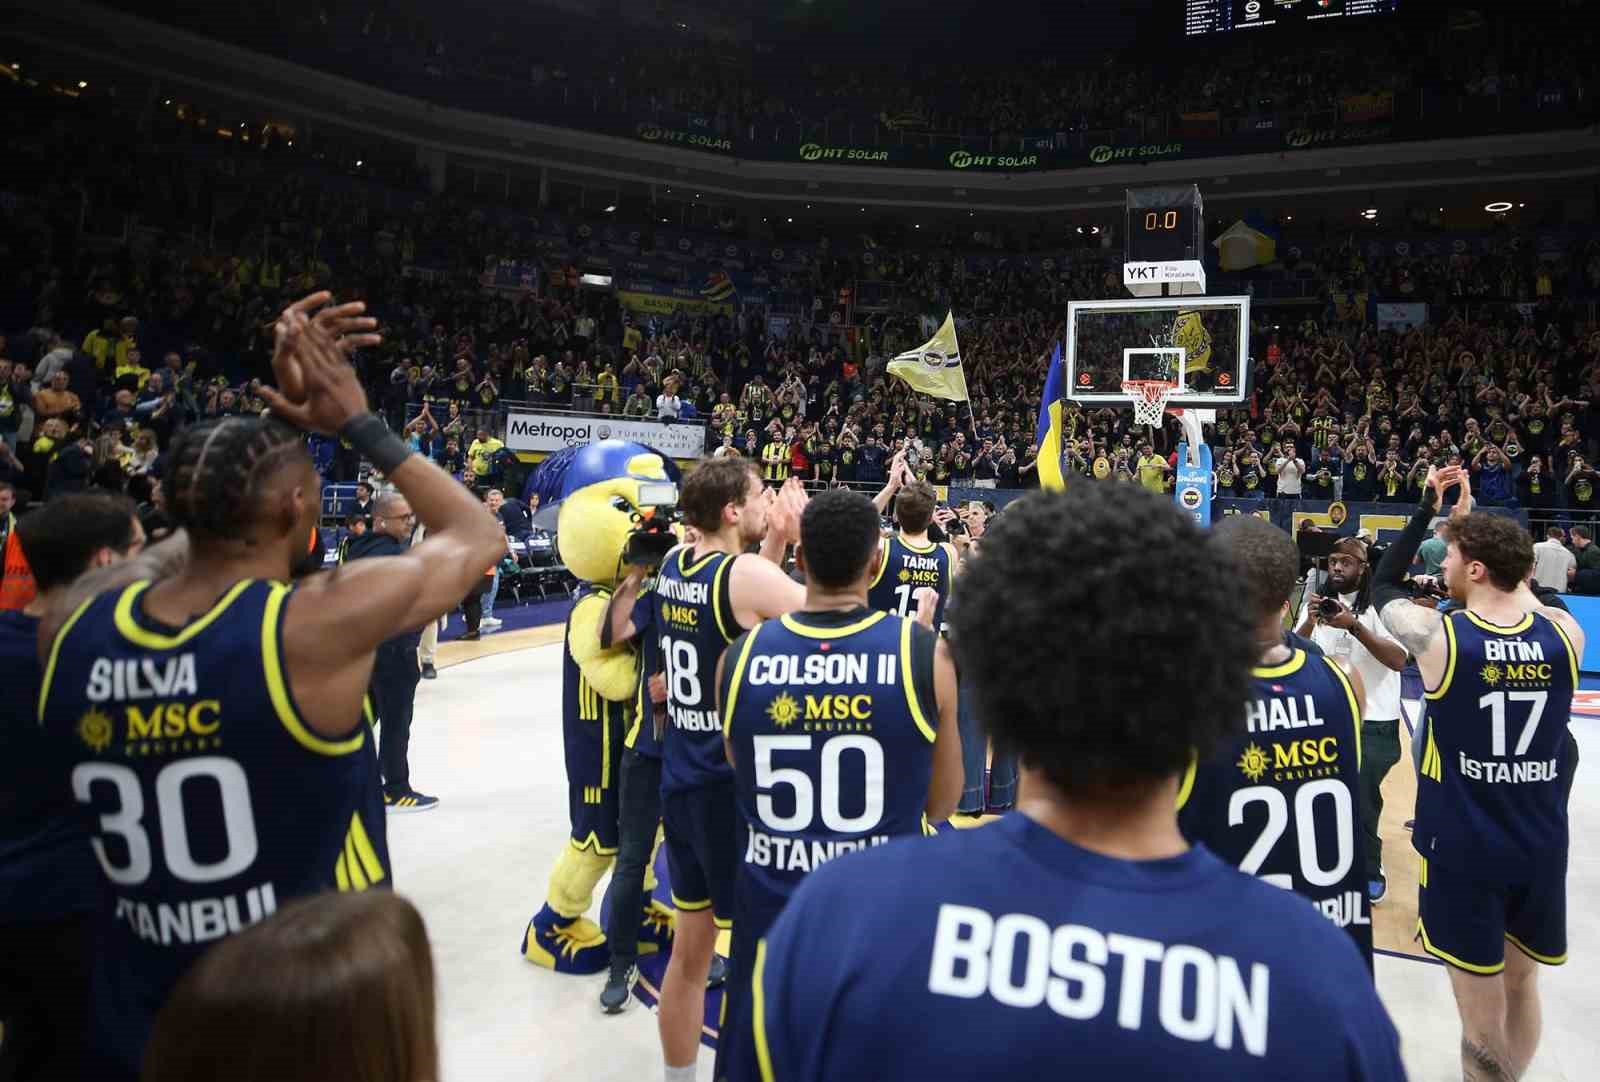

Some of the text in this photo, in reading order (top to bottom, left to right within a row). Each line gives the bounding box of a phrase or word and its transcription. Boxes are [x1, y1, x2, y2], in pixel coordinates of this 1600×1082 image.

[823, 149, 888, 161] HT SOLAR
[973, 155, 1037, 167] HT SOLAR
[1114, 143, 1183, 158] HT SOLAR
[1145, 211, 1177, 230] 0.0
[1127, 266, 1158, 279] YKT
[510, 420, 591, 441] Metropol
[912, 570, 939, 582] MSC
[671, 606, 698, 626] MSC
[86, 653, 198, 701] SILVA
[660, 635, 702, 706] 18
[749, 654, 868, 685] COLSON
[1506, 664, 1552, 680] MSC
[124, 700, 221, 740] MSC
[804, 694, 872, 720] MSC
[1245, 694, 1324, 732] HALL
[1479, 690, 1549, 757] 17
[1272, 736, 1338, 769] MSC
[753, 734, 885, 833] 50
[71, 756, 258, 885] 30
[1228, 778, 1354, 890] 20
[928, 903, 1270, 1057] BOSTON
